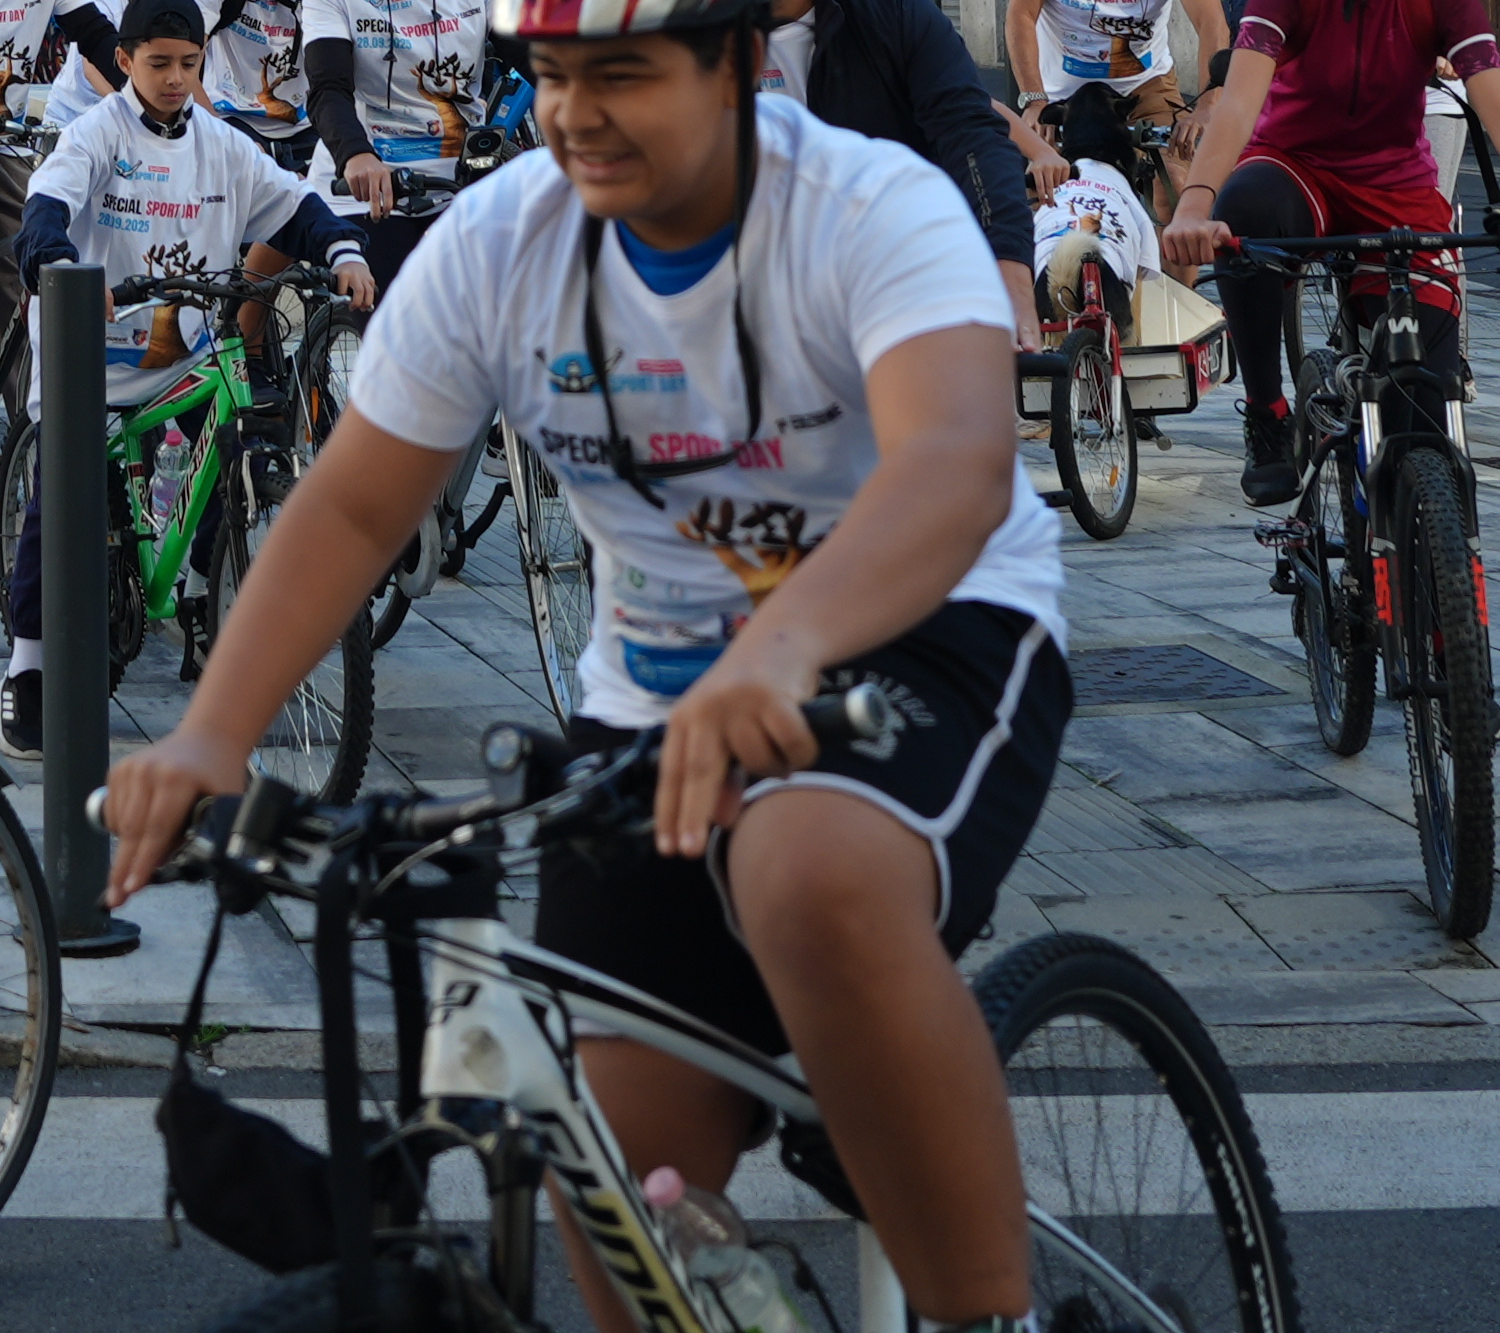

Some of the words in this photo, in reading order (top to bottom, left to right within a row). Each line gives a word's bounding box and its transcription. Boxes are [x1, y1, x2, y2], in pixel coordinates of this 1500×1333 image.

[9, 9, 25, 21] DAY
[102, 193, 142, 215] SPECIAL
[146, 201, 181, 218] SPORT
